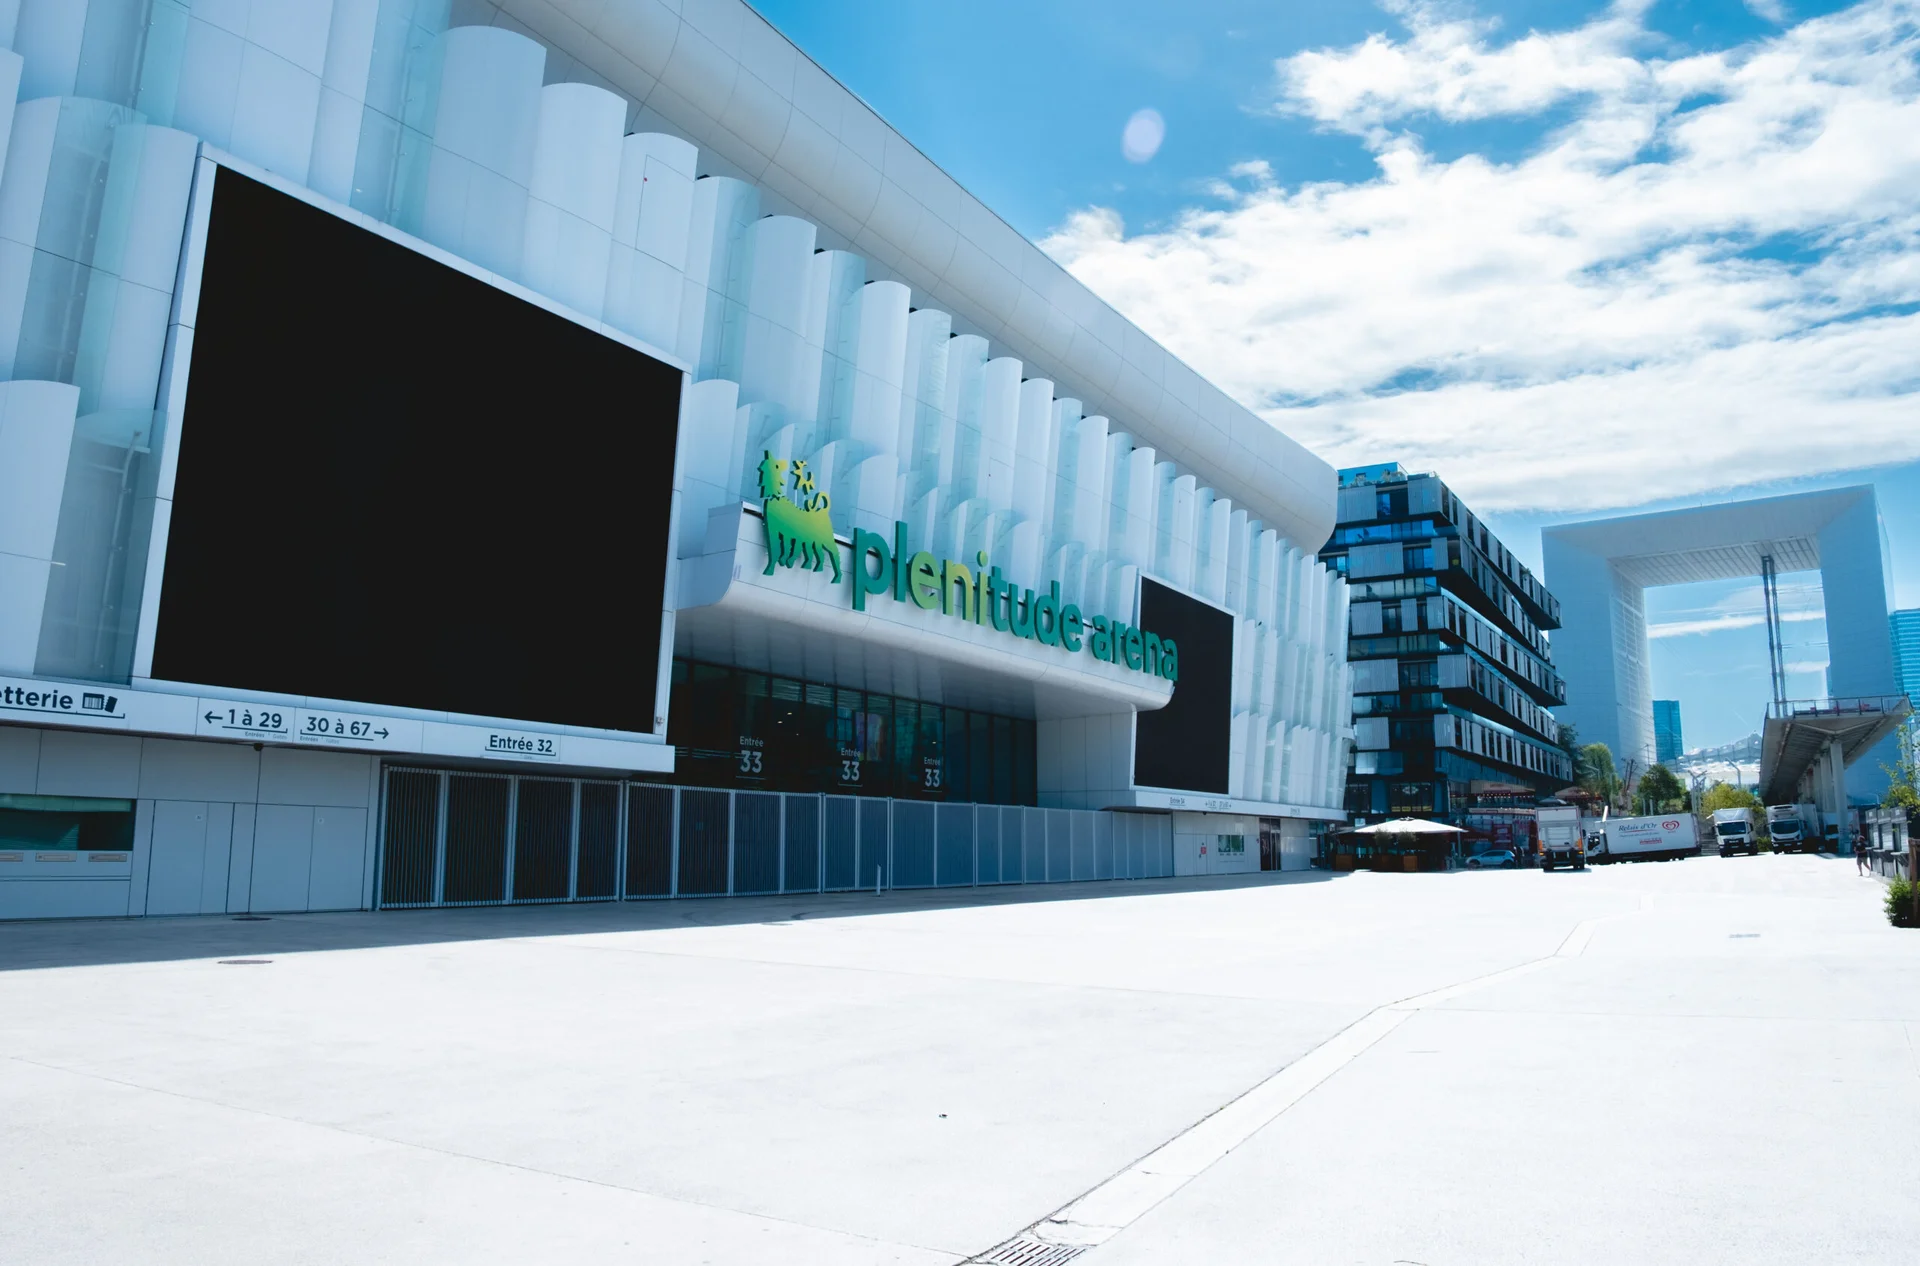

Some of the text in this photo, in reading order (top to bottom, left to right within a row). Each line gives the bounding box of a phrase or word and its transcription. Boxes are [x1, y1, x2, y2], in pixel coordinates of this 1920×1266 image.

[852, 520, 1179, 682] plenitude arena
[0, 686, 74, 710] tterie
[228, 708, 283, 729] 1 à 29
[306, 716, 372, 737] 30 à 67
[489, 734, 553, 753] Entrée 32
[739, 735, 764, 748] Entrée
[739, 749, 763, 774] 33
[840, 747, 861, 758] Entrée
[923, 756, 941, 766] Entrée
[841, 759, 860, 781] 33
[924, 768, 940, 788] 33
